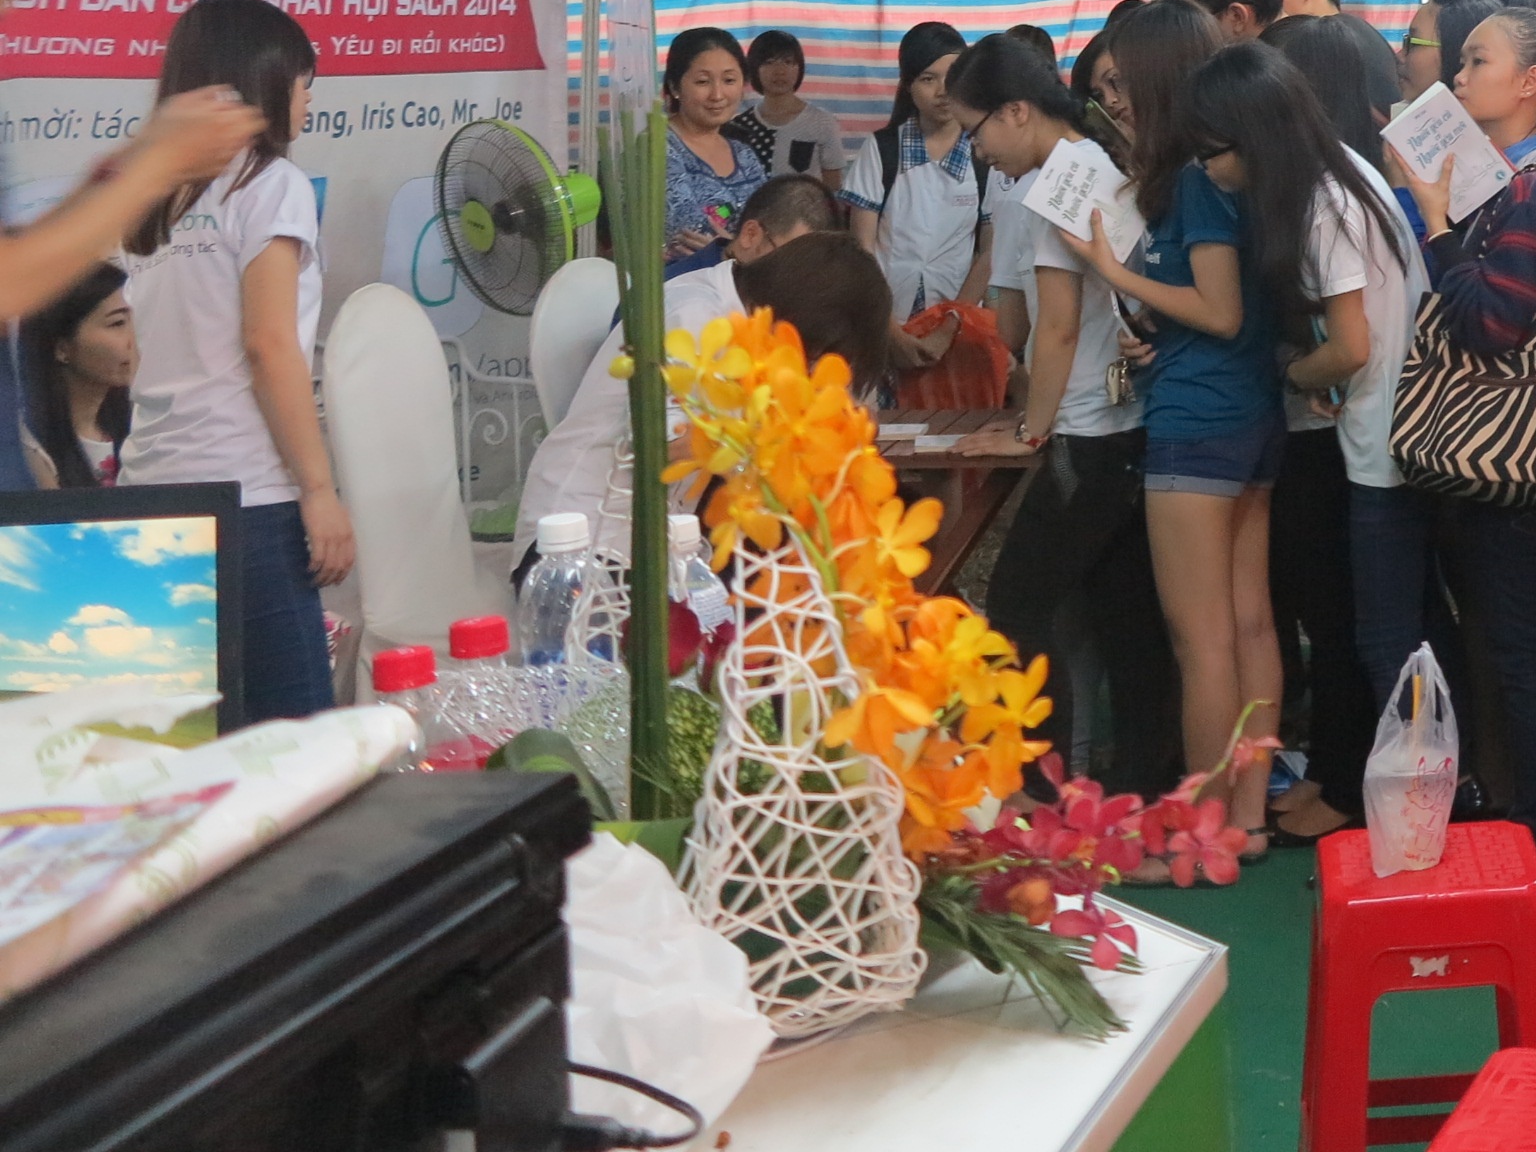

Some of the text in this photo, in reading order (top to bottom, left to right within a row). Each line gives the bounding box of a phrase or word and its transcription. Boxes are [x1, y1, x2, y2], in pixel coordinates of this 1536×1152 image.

[331, 34, 374, 56] YÊU
[382, 38, 404, 55] ĐI
[448, 32, 505, 54] KHÓC)
[361, 104, 395, 131] Iris
[401, 100, 445, 130] Cao,
[493, 97, 523, 122] Joe
